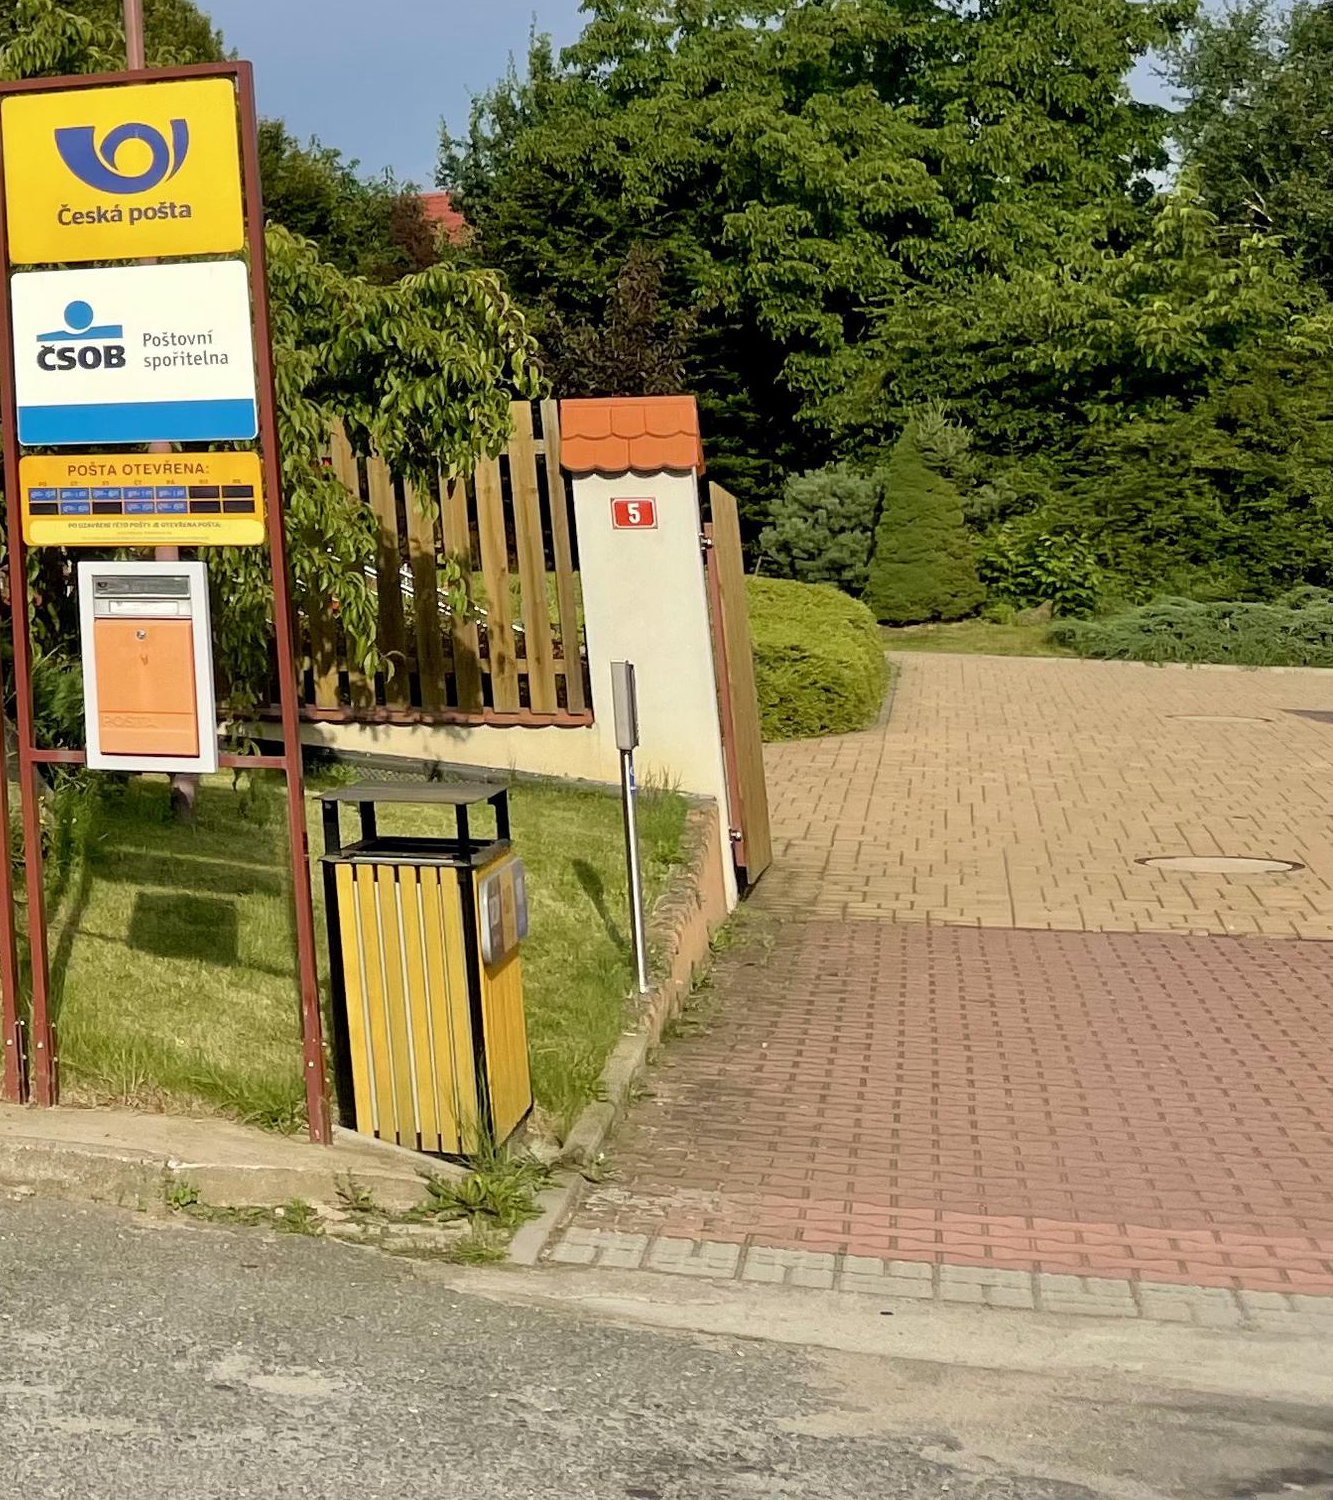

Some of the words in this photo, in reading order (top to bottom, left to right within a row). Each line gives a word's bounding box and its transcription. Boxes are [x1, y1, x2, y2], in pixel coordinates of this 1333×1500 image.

[57, 203, 123, 226] Česká
[128, 201, 192, 226] pošta
[142, 329, 213, 348] Poštovní
[36, 344, 126, 371] ČSOB
[143, 350, 229, 371] spořitelna
[68, 461, 117, 476] POŠTA
[122, 460, 210, 476] OTEVŘENA:
[627, 503, 641, 524] 5
